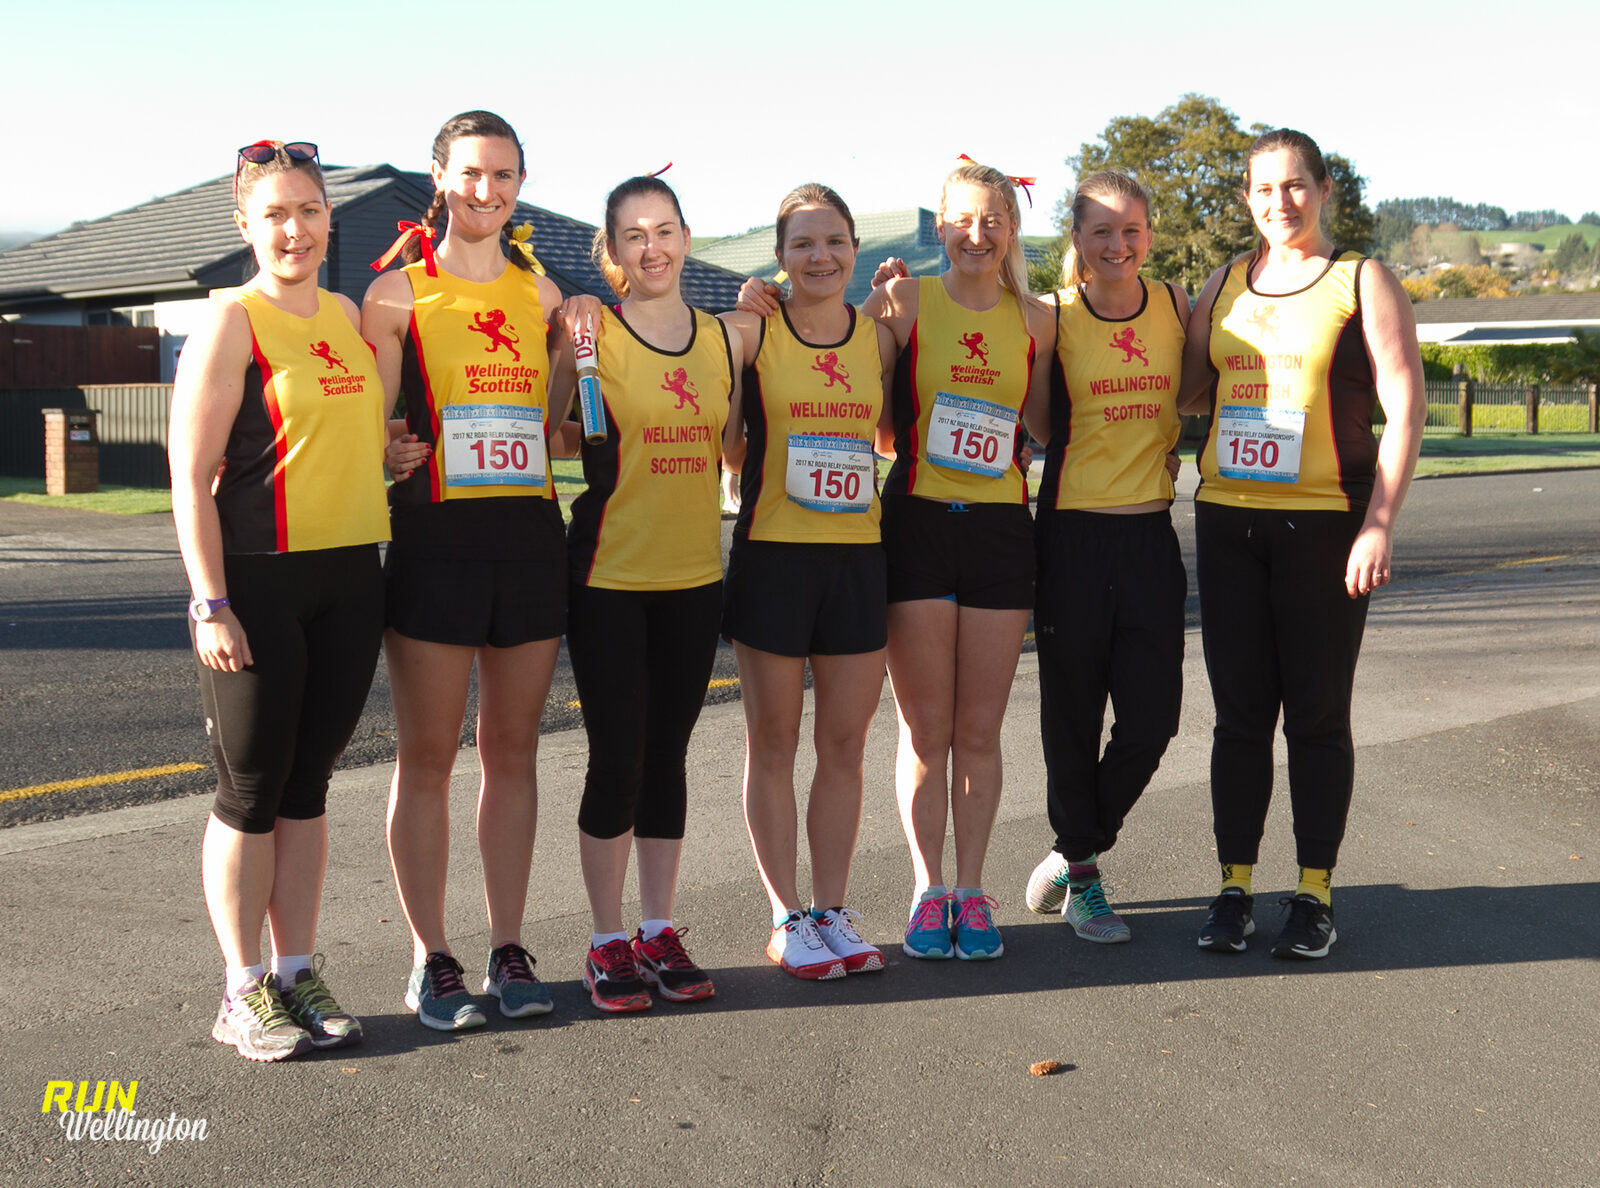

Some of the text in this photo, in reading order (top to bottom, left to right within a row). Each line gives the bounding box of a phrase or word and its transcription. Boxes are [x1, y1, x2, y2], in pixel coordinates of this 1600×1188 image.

[574, 329, 593, 360] 50
[1225, 354, 1303, 371] WELLINGTON
[318, 374, 366, 386] Wellington
[465, 363, 539, 380] Wellington
[950, 365, 1001, 378] Wellington
[950, 372, 995, 386] Scottish
[323, 382, 364, 396] Scottish
[468, 378, 532, 394] Scottish
[1089, 375, 1171, 396] WELLINGTON
[1231, 383, 1291, 399] SCOTTISH
[789, 402, 873, 420] WELLINGTON
[1103, 403, 1161, 422] SCOTTISH
[957, 419, 970, 429] ROAD
[970, 422, 983, 431] RELAY
[452, 432, 465, 440] 2017
[474, 431, 488, 439] ROAD
[489, 431, 504, 439] RELAY
[950, 428, 999, 463] 150
[1229, 437, 1279, 468] 150
[470, 440, 528, 470] 150
[650, 456, 707, 475] SCOTTISH
[815, 460, 828, 469] ROAD
[828, 461, 842, 470] RELAY
[809, 468, 860, 500] 150
